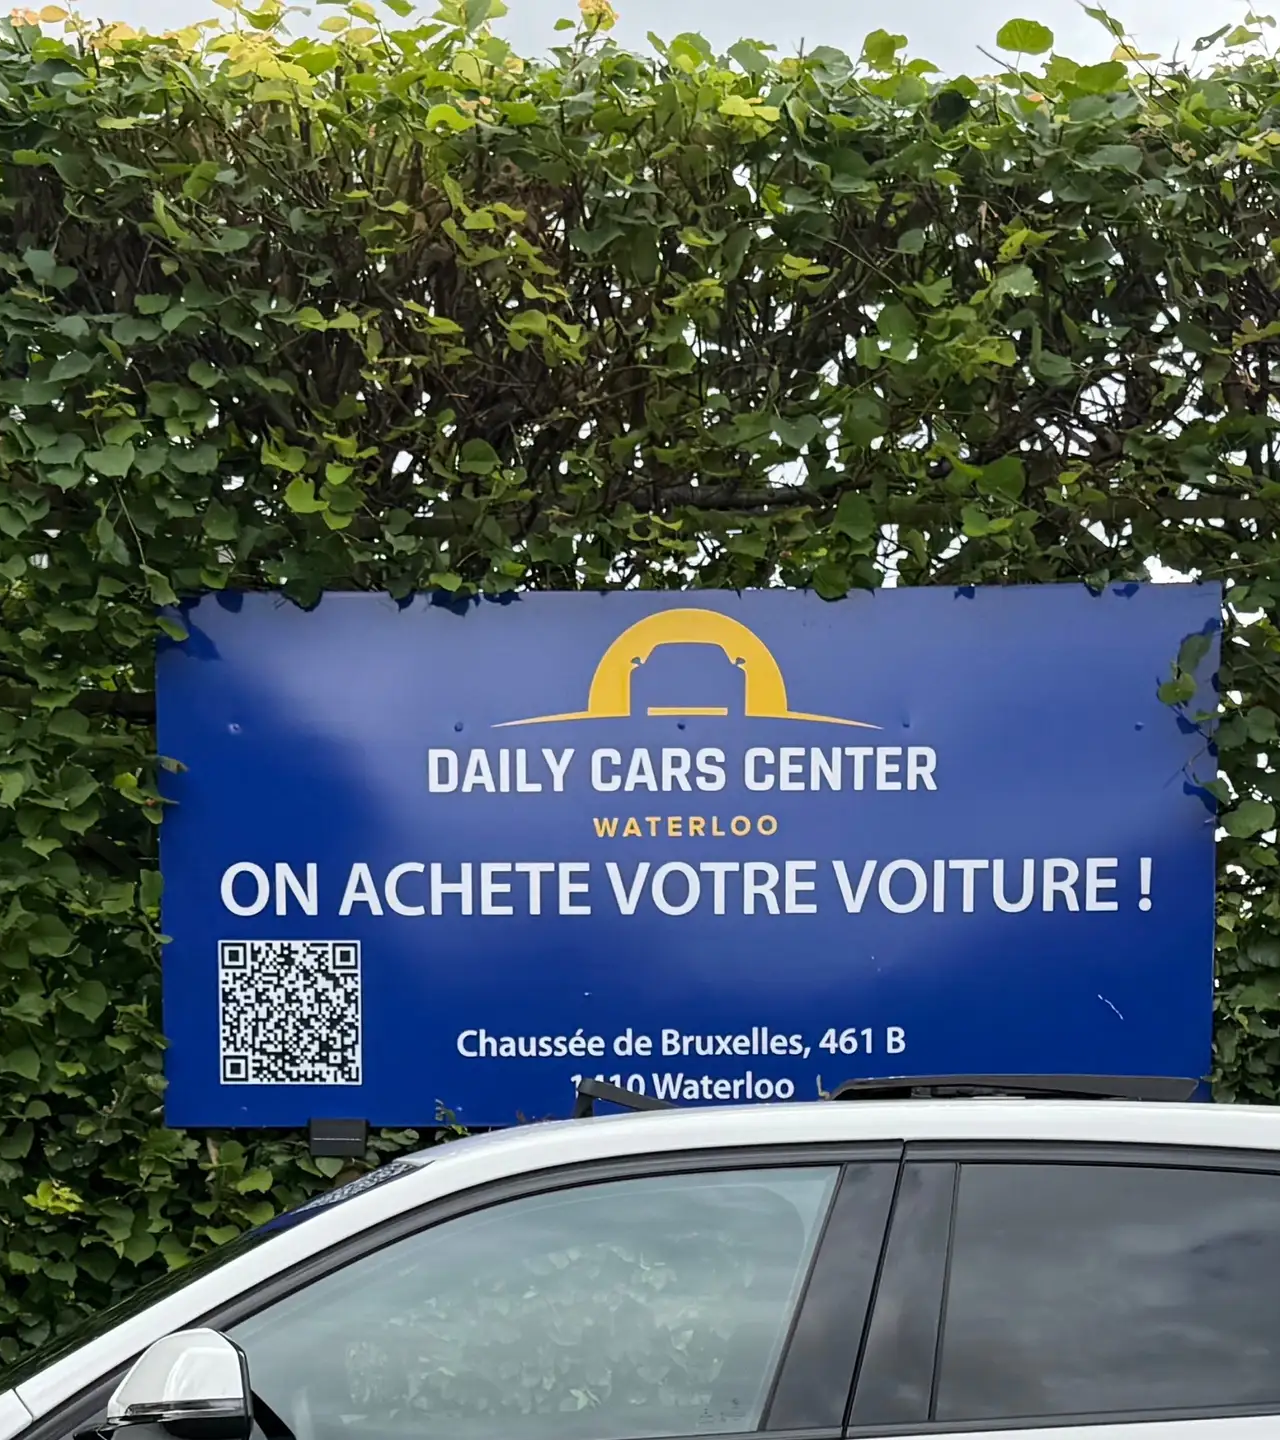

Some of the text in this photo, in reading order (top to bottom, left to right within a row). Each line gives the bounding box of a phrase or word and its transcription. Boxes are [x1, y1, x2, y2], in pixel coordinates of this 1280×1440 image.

[428, 746, 938, 793] DAILY CARS CENTER
[594, 815, 779, 838] WATERLOO
[220, 857, 1153, 917] ON ACHETE VOTRE VOITURE !
[456, 1026, 907, 1060] Chaussée de Bruxelles, 461 B
[652, 1070, 795, 1100] Waterloo
